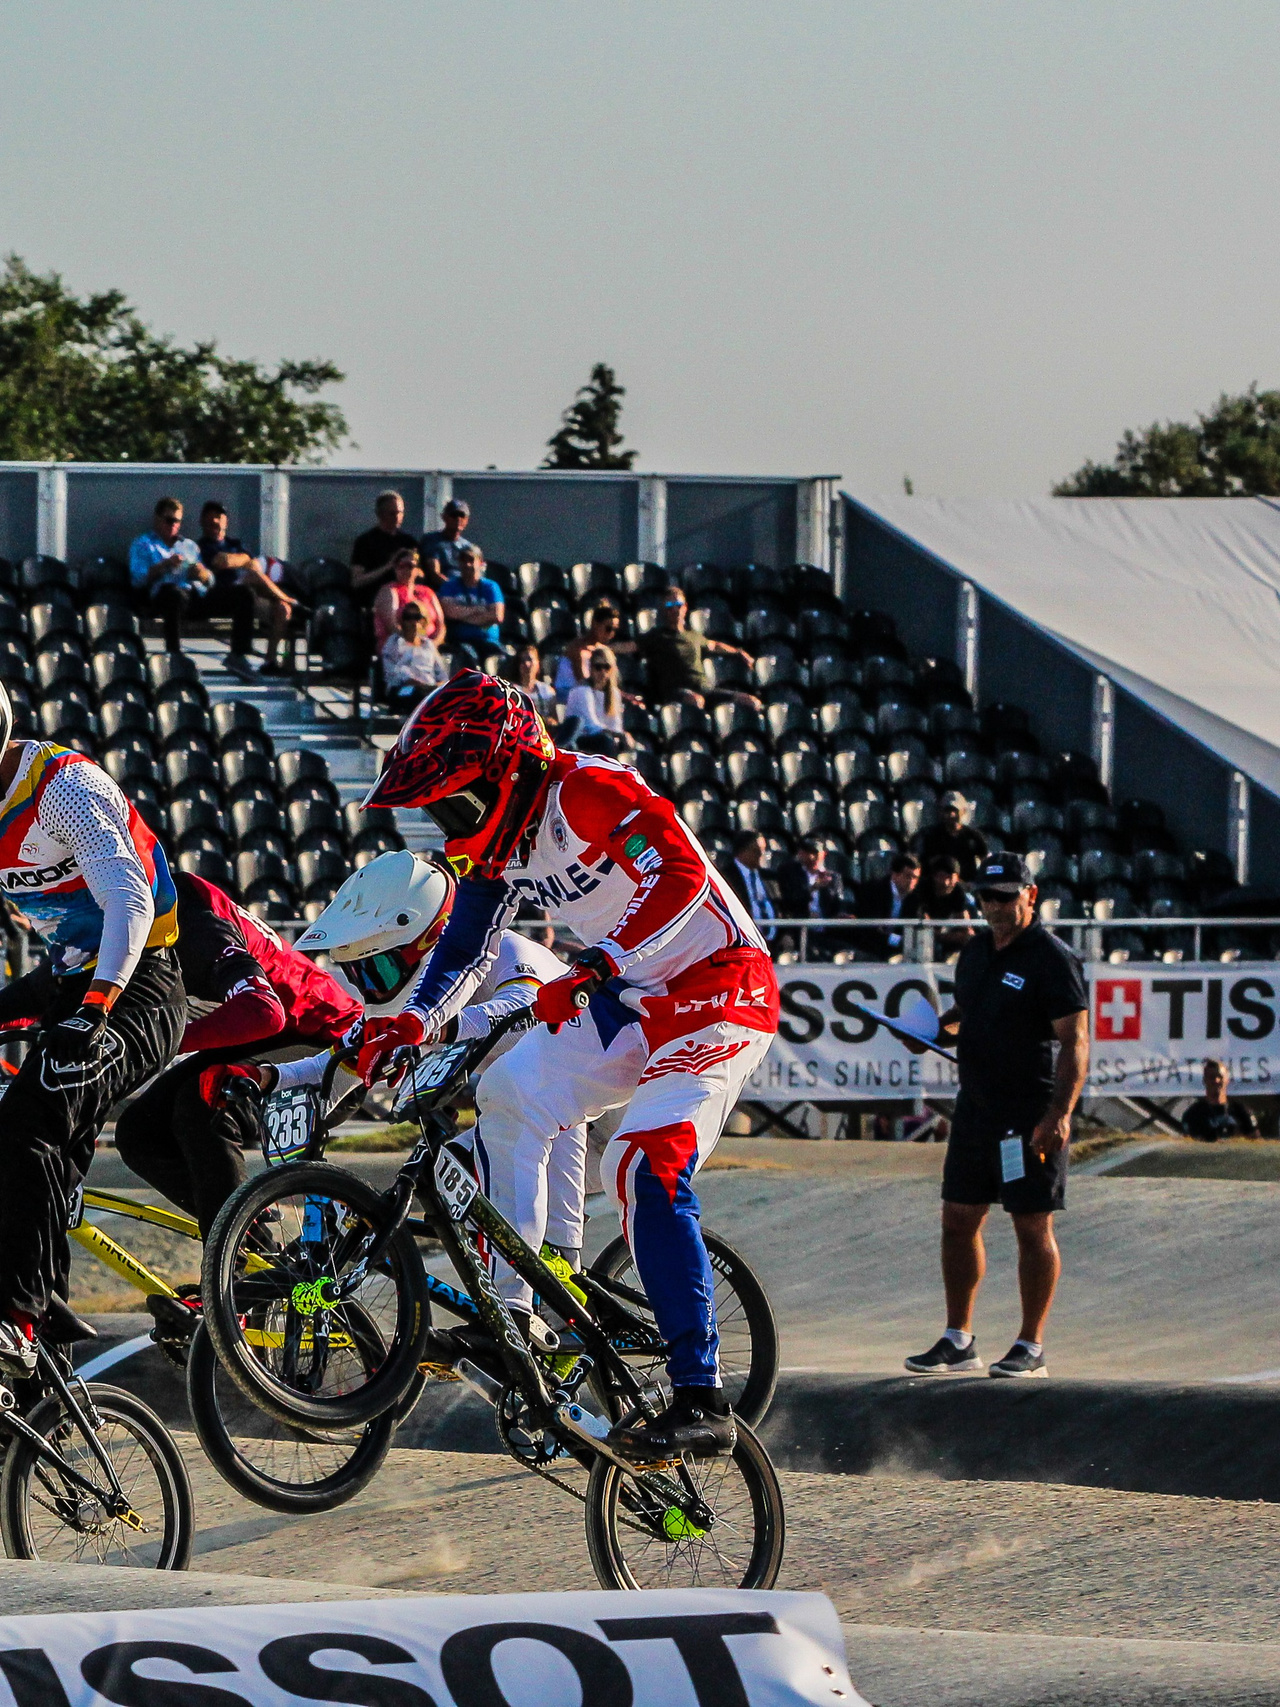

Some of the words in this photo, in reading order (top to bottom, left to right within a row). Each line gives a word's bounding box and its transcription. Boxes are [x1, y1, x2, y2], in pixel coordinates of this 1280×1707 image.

[7, 855, 79, 890] ADOR
[511, 862, 601, 908] CHILE
[1152, 977, 1280, 1041] TIS
[750, 1060, 818, 1088] CHES
[835, 1059, 921, 1088] SINCE
[1143, 1057, 1269, 1083] WATES
[268, 1105, 308, 1152] 233
[438, 1157, 475, 1206] 185
